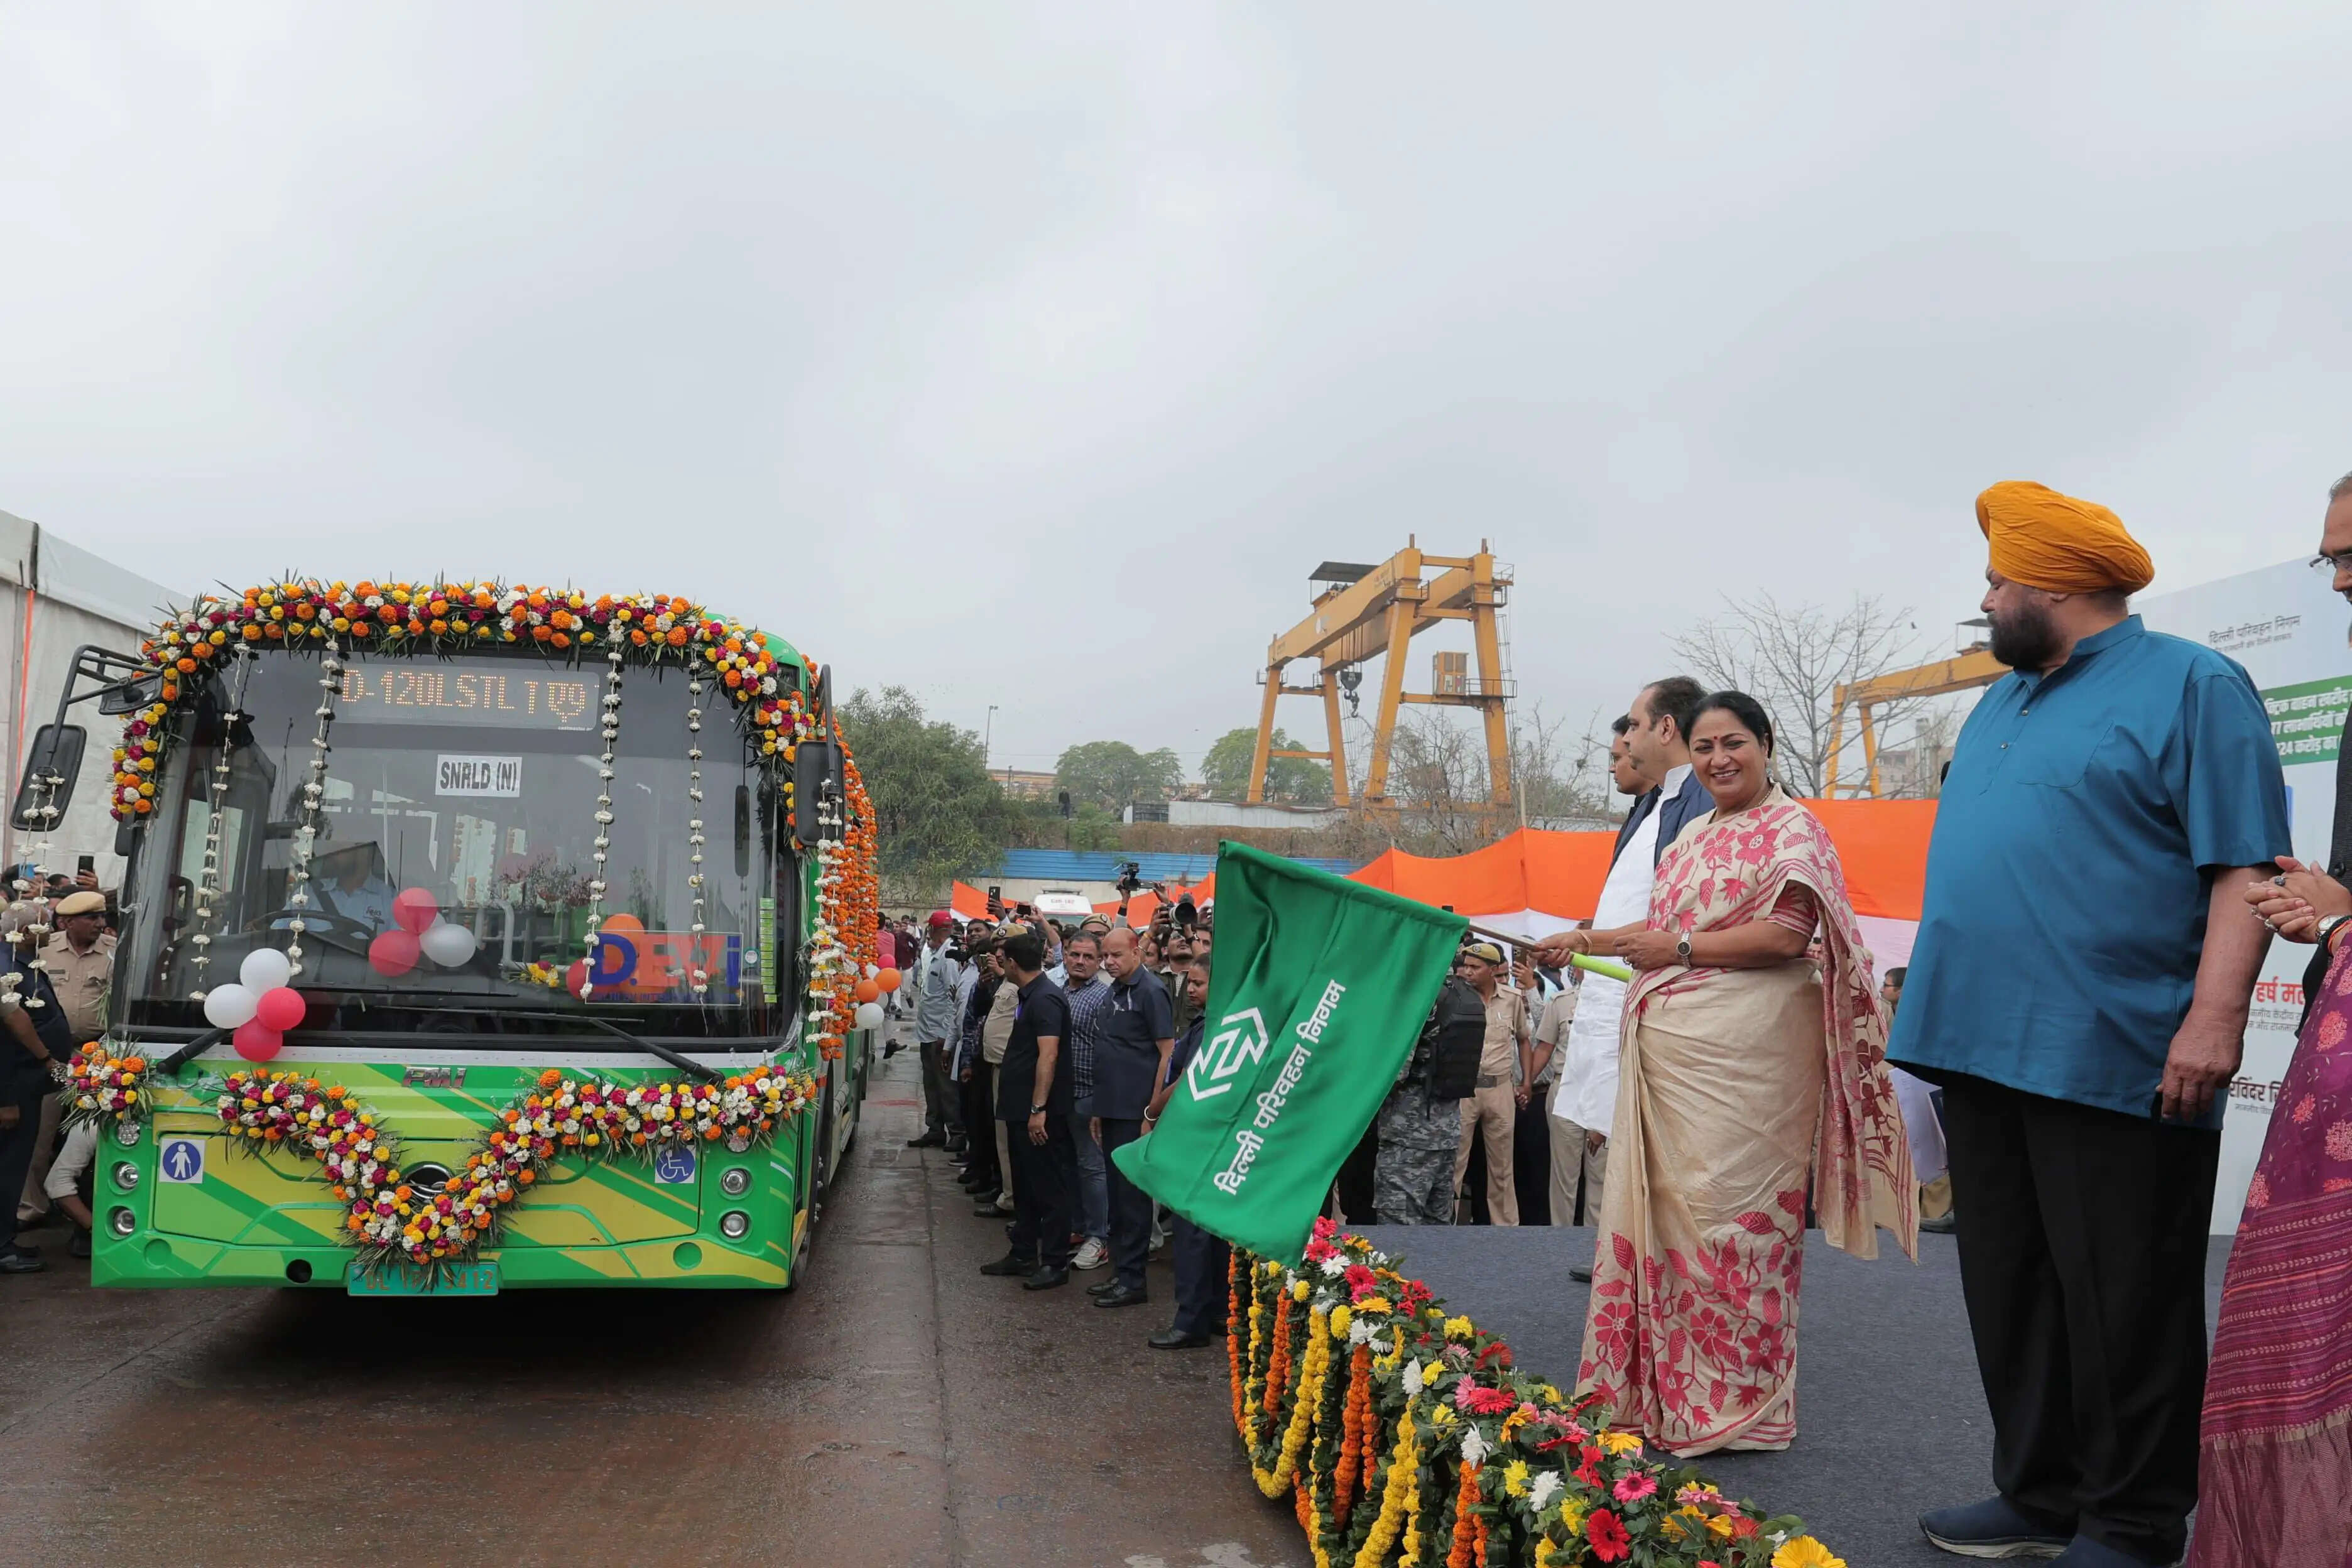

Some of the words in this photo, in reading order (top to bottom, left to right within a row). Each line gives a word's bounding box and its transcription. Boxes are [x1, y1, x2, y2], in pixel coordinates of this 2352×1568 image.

[2209, 626, 2234, 643] दिल्ली
[2237, 623, 2273, 637] परिवहन
[2275, 614, 2302, 629] निगम
[440, 761, 491, 790] SNRLD
[496, 761, 518, 792] (N)
[2255, 976, 2278, 1003] हर्ष
[1214, 1130, 1263, 1195] दिल्ली
[1253, 1043, 1311, 1128] परिवहन
[1296, 979, 1346, 1044] निगम
